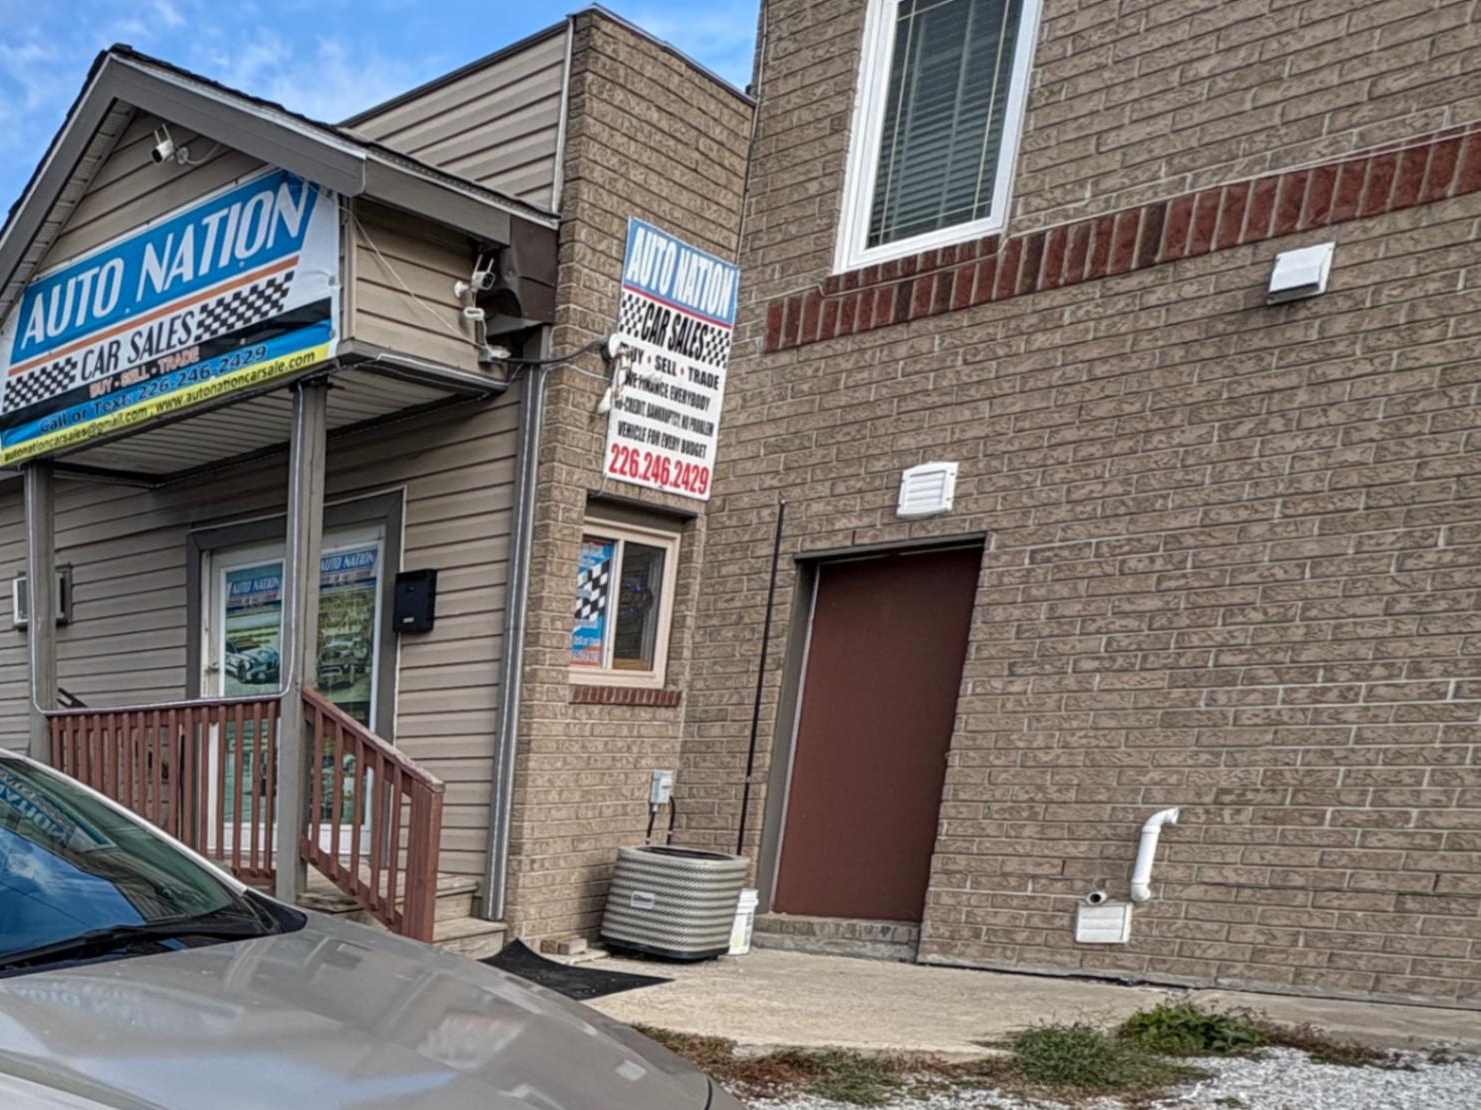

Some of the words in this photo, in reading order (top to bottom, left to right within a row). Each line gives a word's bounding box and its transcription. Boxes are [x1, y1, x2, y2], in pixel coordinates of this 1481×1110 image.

[20, 257, 123, 350] AUTO
[136, 182, 309, 303] NATION
[626, 226, 677, 295] AUTO
[672, 247, 735, 319] NATION
[81, 340, 121, 381] CAR
[127, 311, 196, 364] SALES
[640, 302, 671, 347] CAR
[667, 313, 709, 361] SALES
[39, 414, 67, 432] Call
[72, 409, 88, 421] or
[139, 345, 267, 399] 226-246-2429
[89, 377, 113, 398] BUY
[121, 366, 151, 387] SELL
[158, 346, 199, 374] TRADE
[655, 355, 677, 377] SELL
[688, 366, 720, 390] TRADE
[670, 382, 710, 412] EVERYBODY
[609, 442, 710, 495] 226.246.2429
